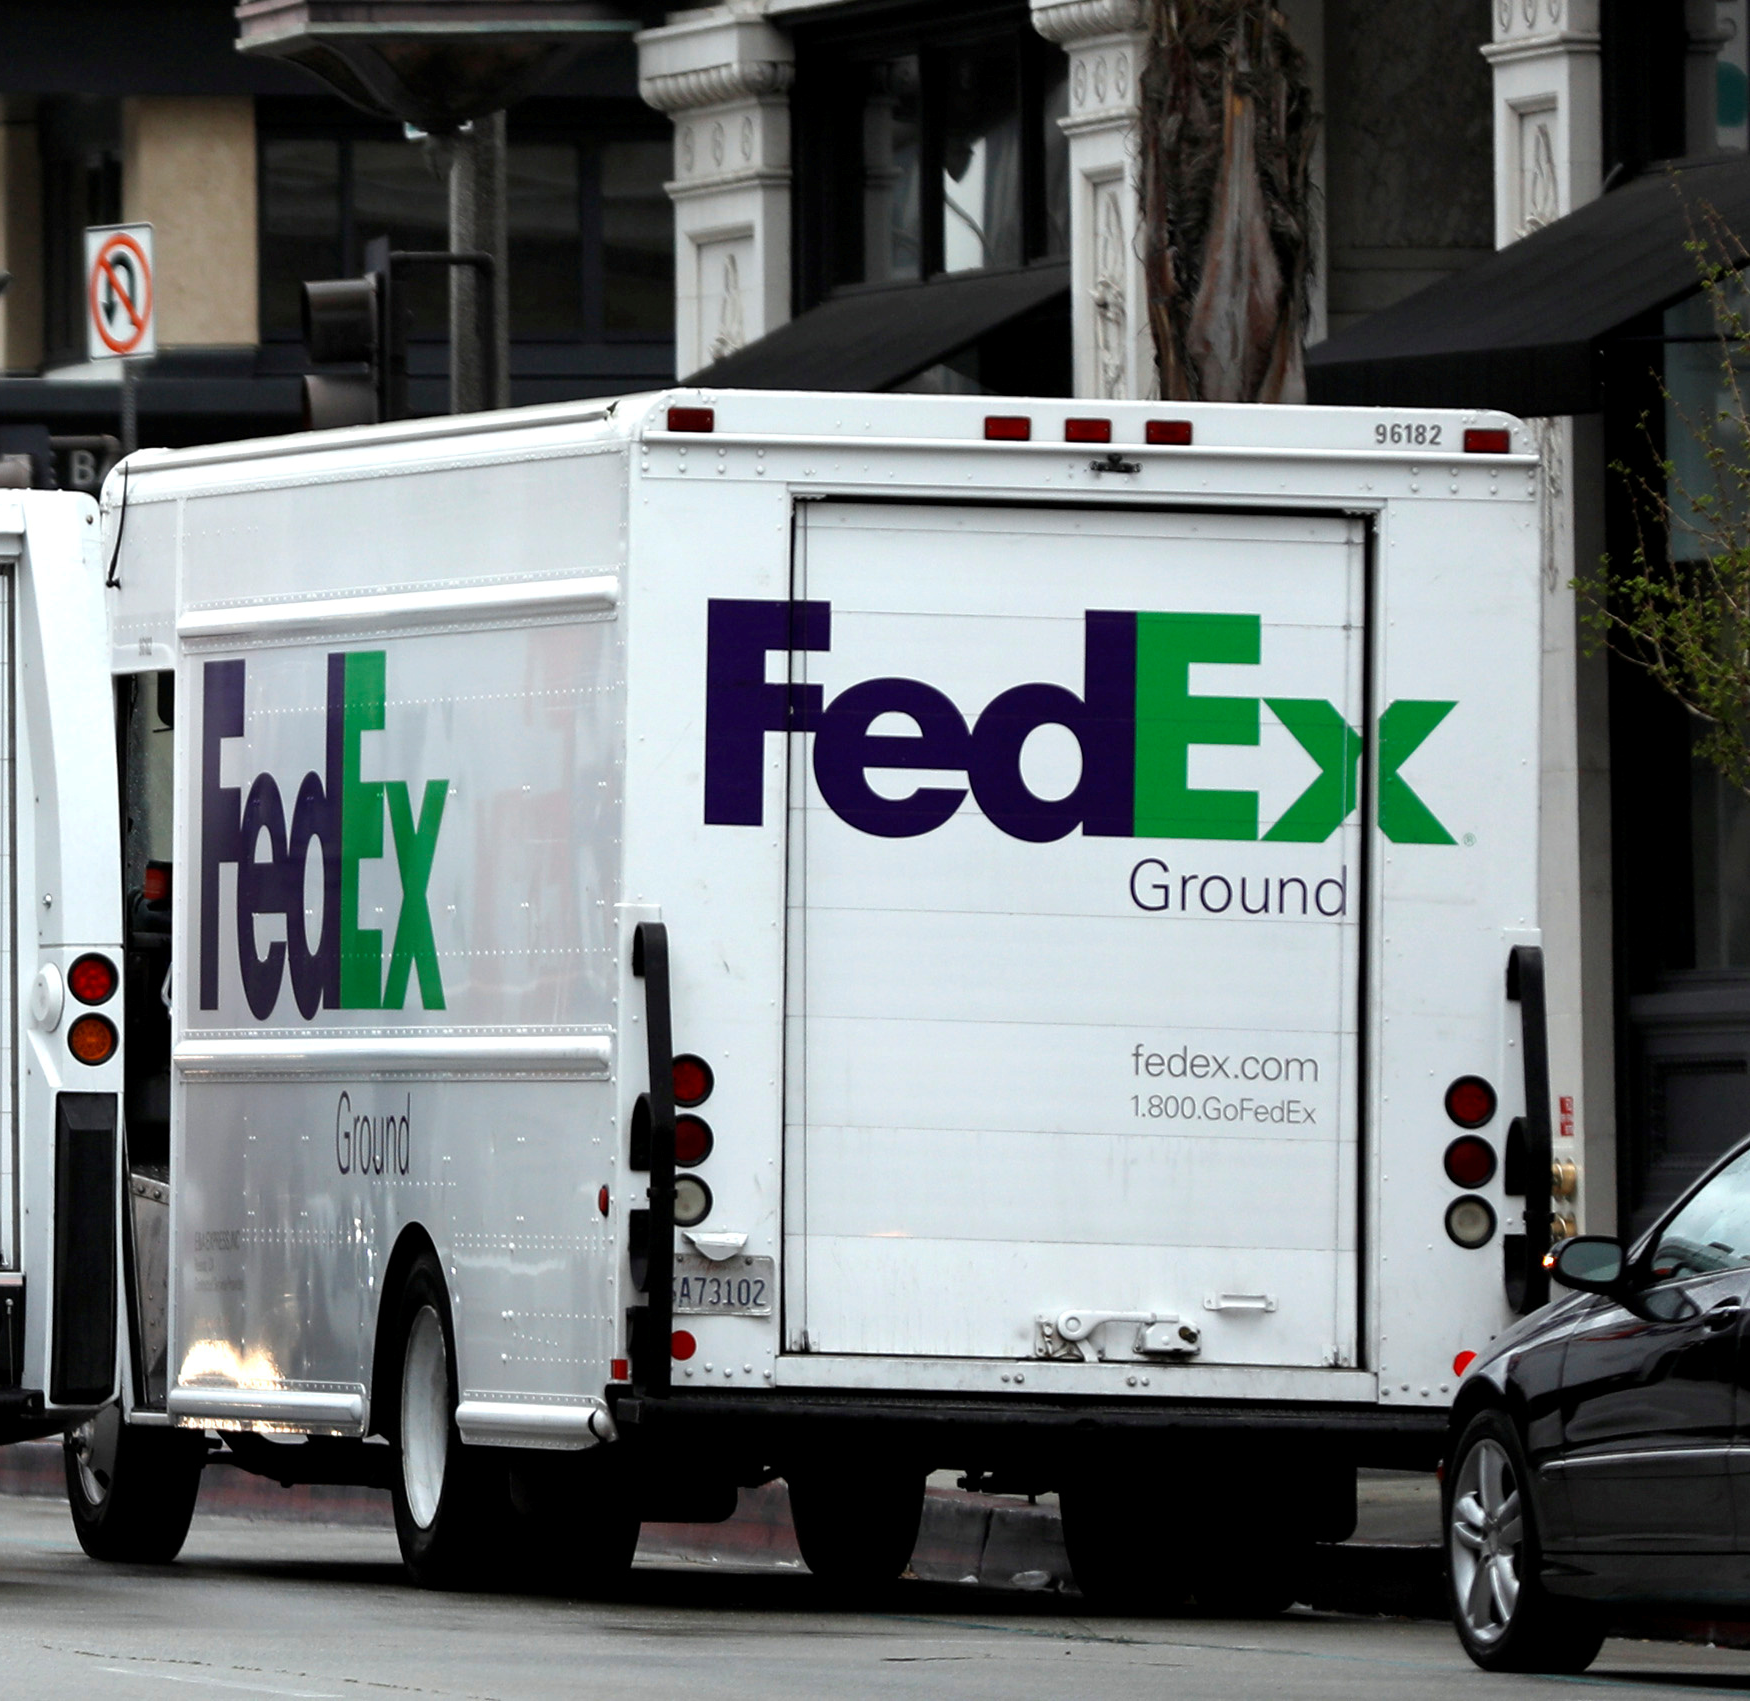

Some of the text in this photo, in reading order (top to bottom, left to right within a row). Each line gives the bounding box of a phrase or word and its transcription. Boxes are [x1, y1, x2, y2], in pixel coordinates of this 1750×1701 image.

[1375, 423, 1442, 445] 96182
[704, 598, 1460, 846] FedEx
[200, 650, 449, 1021] FedEx
[1130, 857, 1346, 916] Ground
[1131, 1043, 1319, 1082] fedex.com
[336, 1091, 411, 1176] Ground
[1131, 1094, 1317, 1125] 1.800.GoFedEx
